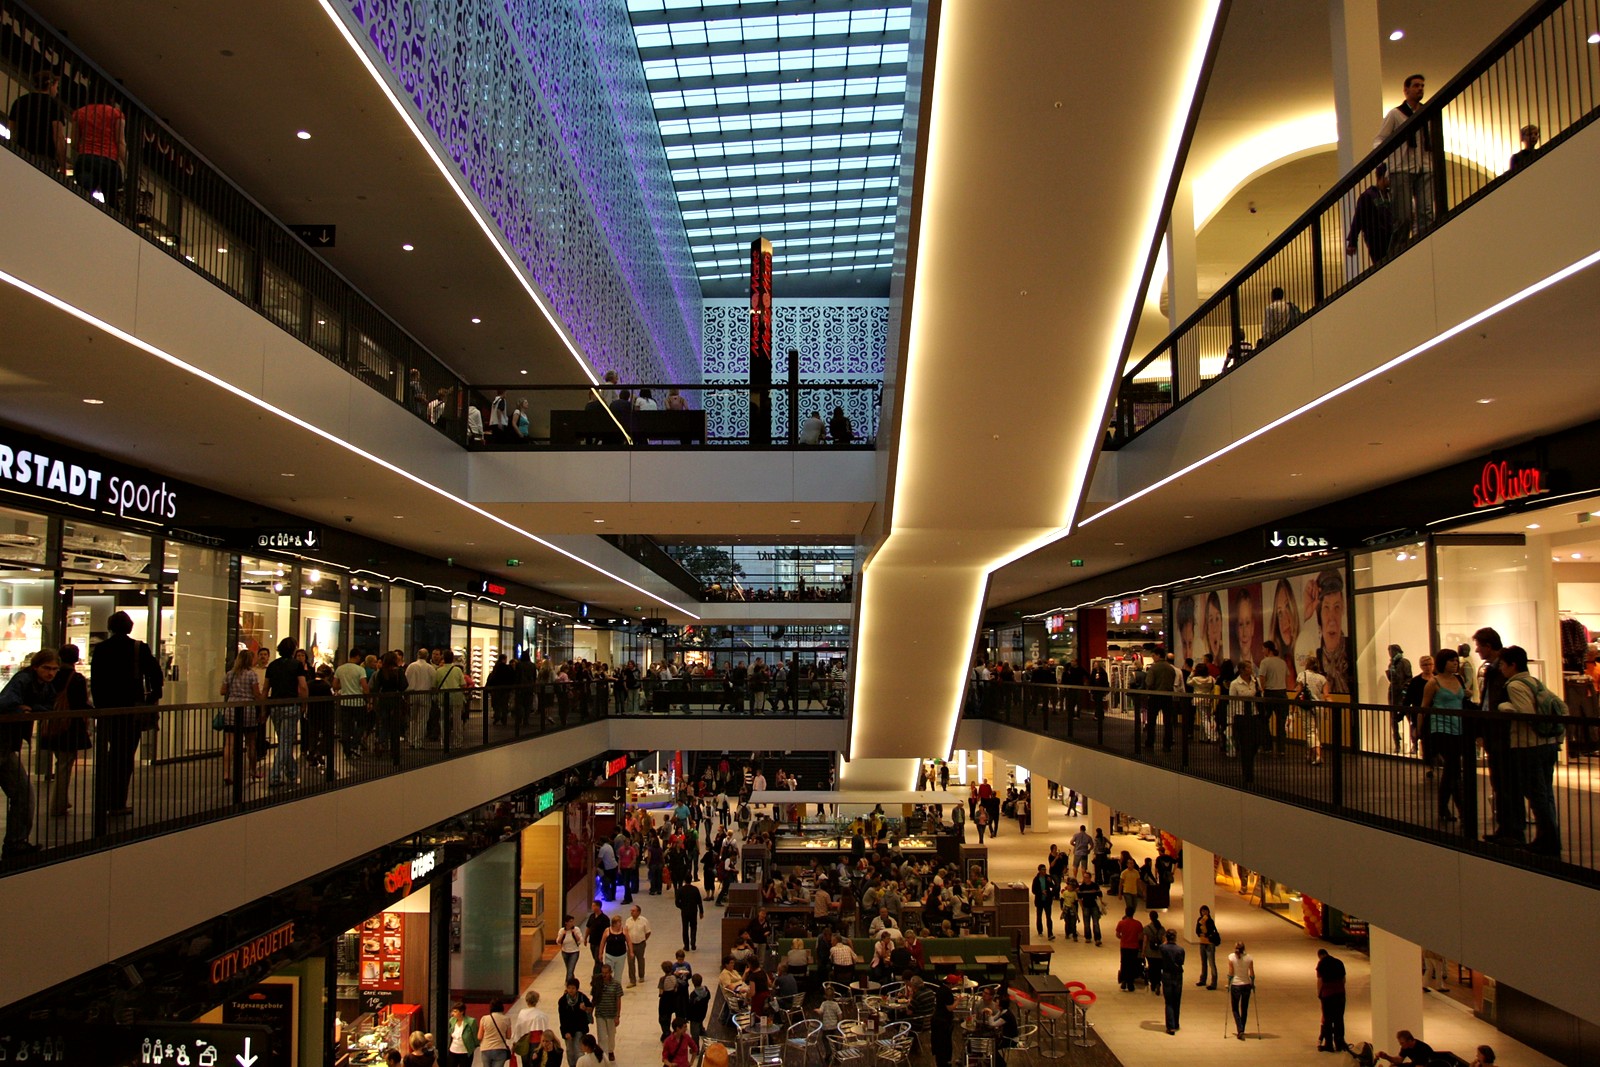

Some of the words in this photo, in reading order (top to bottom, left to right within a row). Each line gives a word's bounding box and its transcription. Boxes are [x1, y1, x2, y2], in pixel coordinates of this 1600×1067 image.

[751, 250, 760, 295] Markt
[751, 307, 759, 357] Media
[0, 444, 102, 500] RSTADT
[109, 476, 177, 518] sports
[211, 950, 240, 985] CITY
[241, 922, 295, 970] BAGUETTE
[232, 1001, 284, 1011] Tagesangebote
